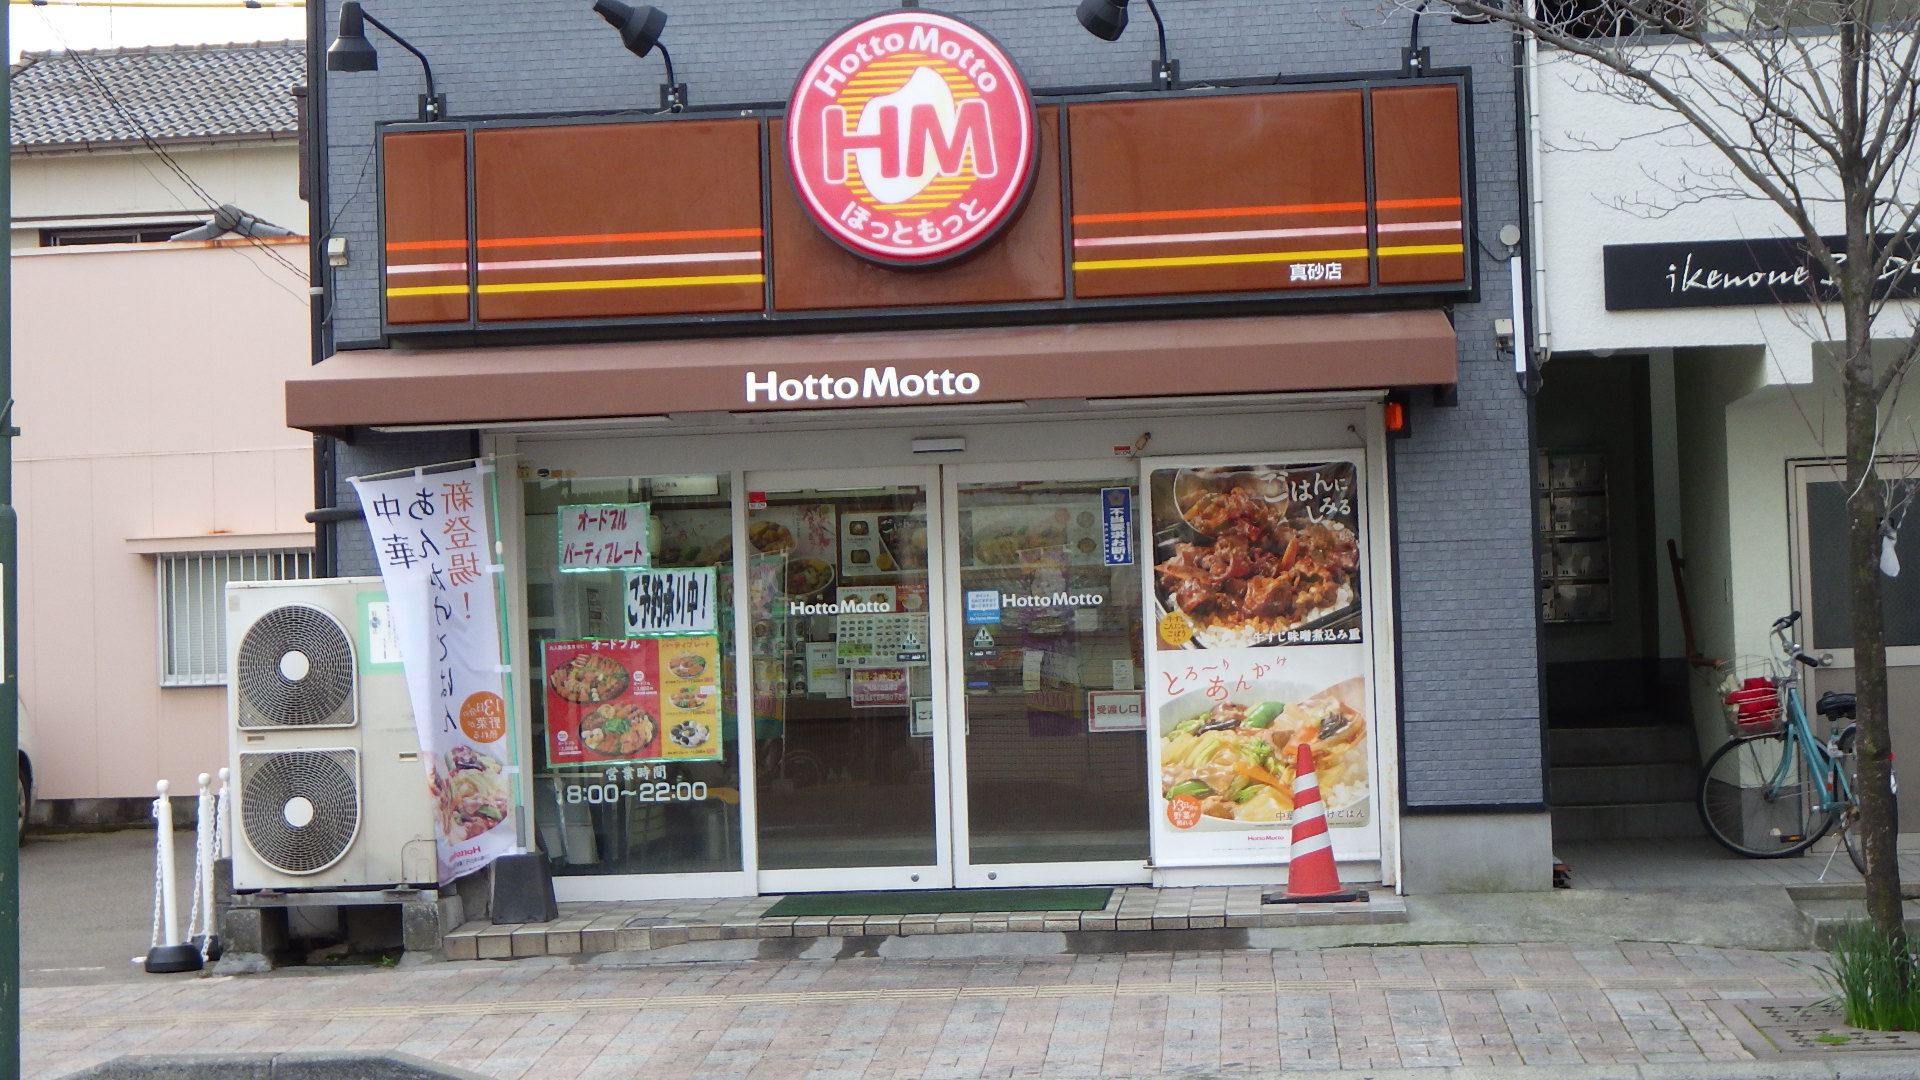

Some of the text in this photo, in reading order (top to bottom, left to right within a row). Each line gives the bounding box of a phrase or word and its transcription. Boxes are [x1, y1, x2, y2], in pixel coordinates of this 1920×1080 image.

[823, 99, 997, 184] HM
[840, 198, 987, 246] ほっともっと
[1289, 262, 1342, 281] 真砂店
[1306, 496, 1351, 524] しみる
[591, 639, 641, 650] オードブル
[1096, 704, 1139, 715] 受渡し口
[605, 764, 667, 781] 営業時間
